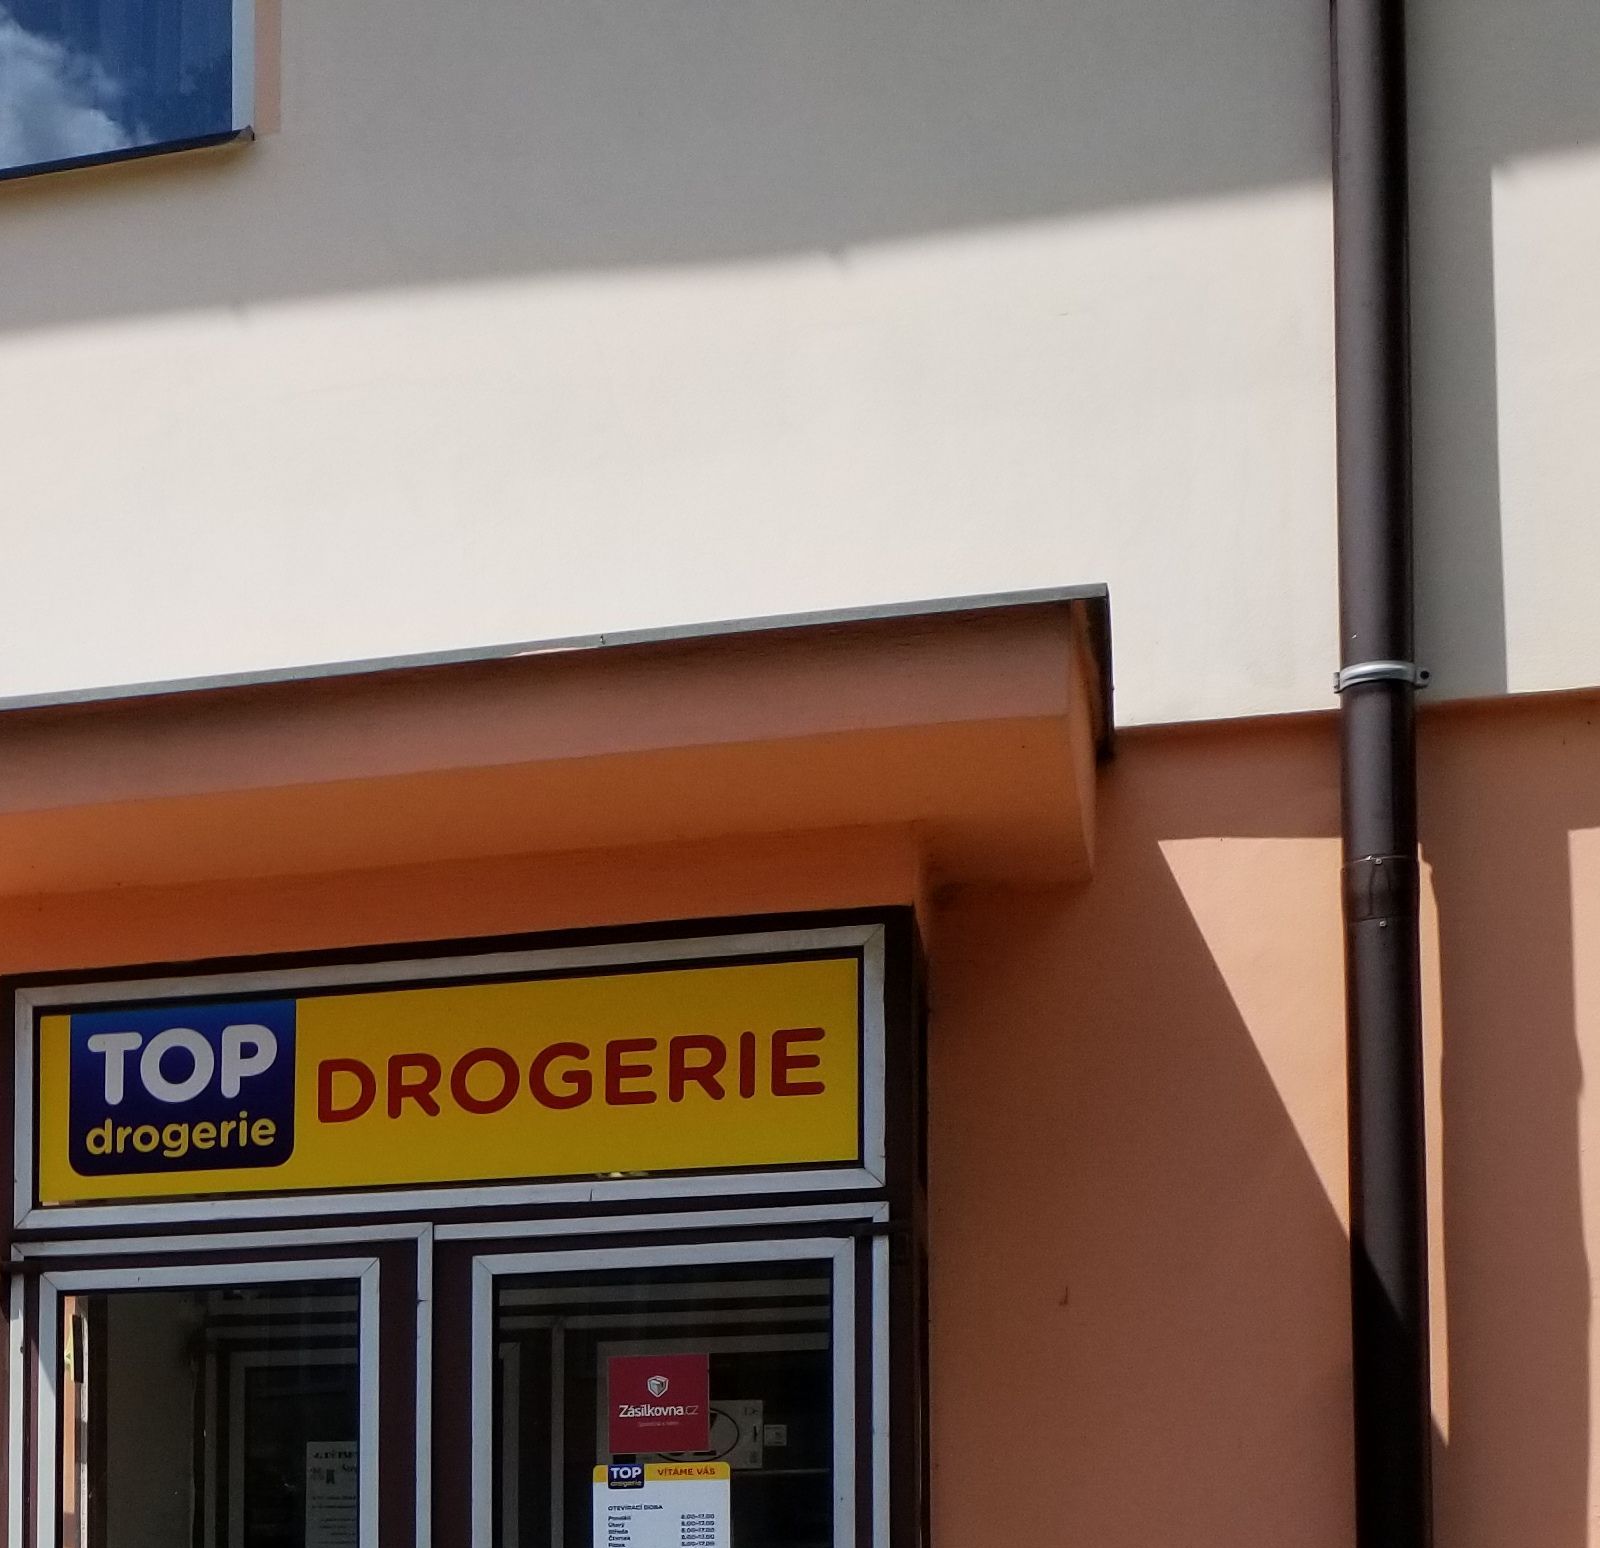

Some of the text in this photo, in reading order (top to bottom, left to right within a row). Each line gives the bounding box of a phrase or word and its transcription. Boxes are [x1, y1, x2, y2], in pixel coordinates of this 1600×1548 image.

[86, 1022, 279, 1107] TOP
[317, 1026, 827, 1125] DROGERIE
[85, 1110, 277, 1159] drogerie
[610, 1466, 642, 1480] TOP
[696, 1467, 716, 1476] VÁS
